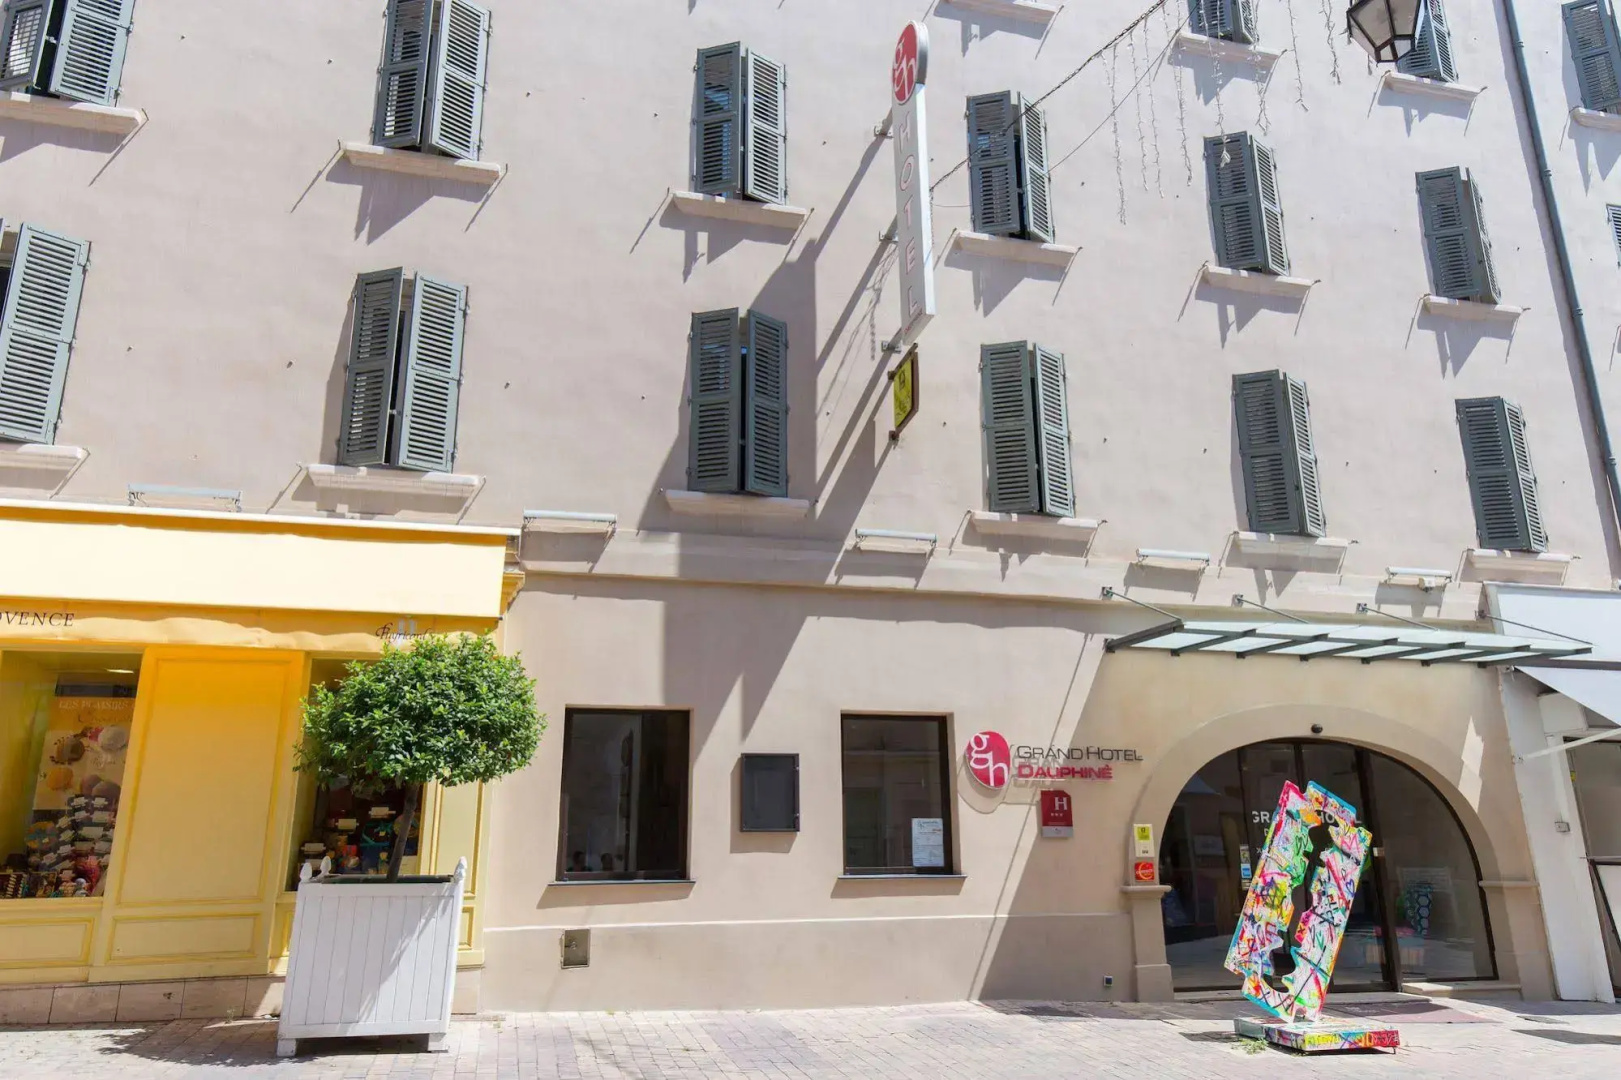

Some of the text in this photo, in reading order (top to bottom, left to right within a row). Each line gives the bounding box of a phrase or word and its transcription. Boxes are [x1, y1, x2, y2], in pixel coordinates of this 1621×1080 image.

[899, 110, 918, 318] HOTEL
[970, 733, 1009, 787] gh
[1017, 745, 1144, 762] GRAND HOTEL
[1054, 796, 1068, 811] H
